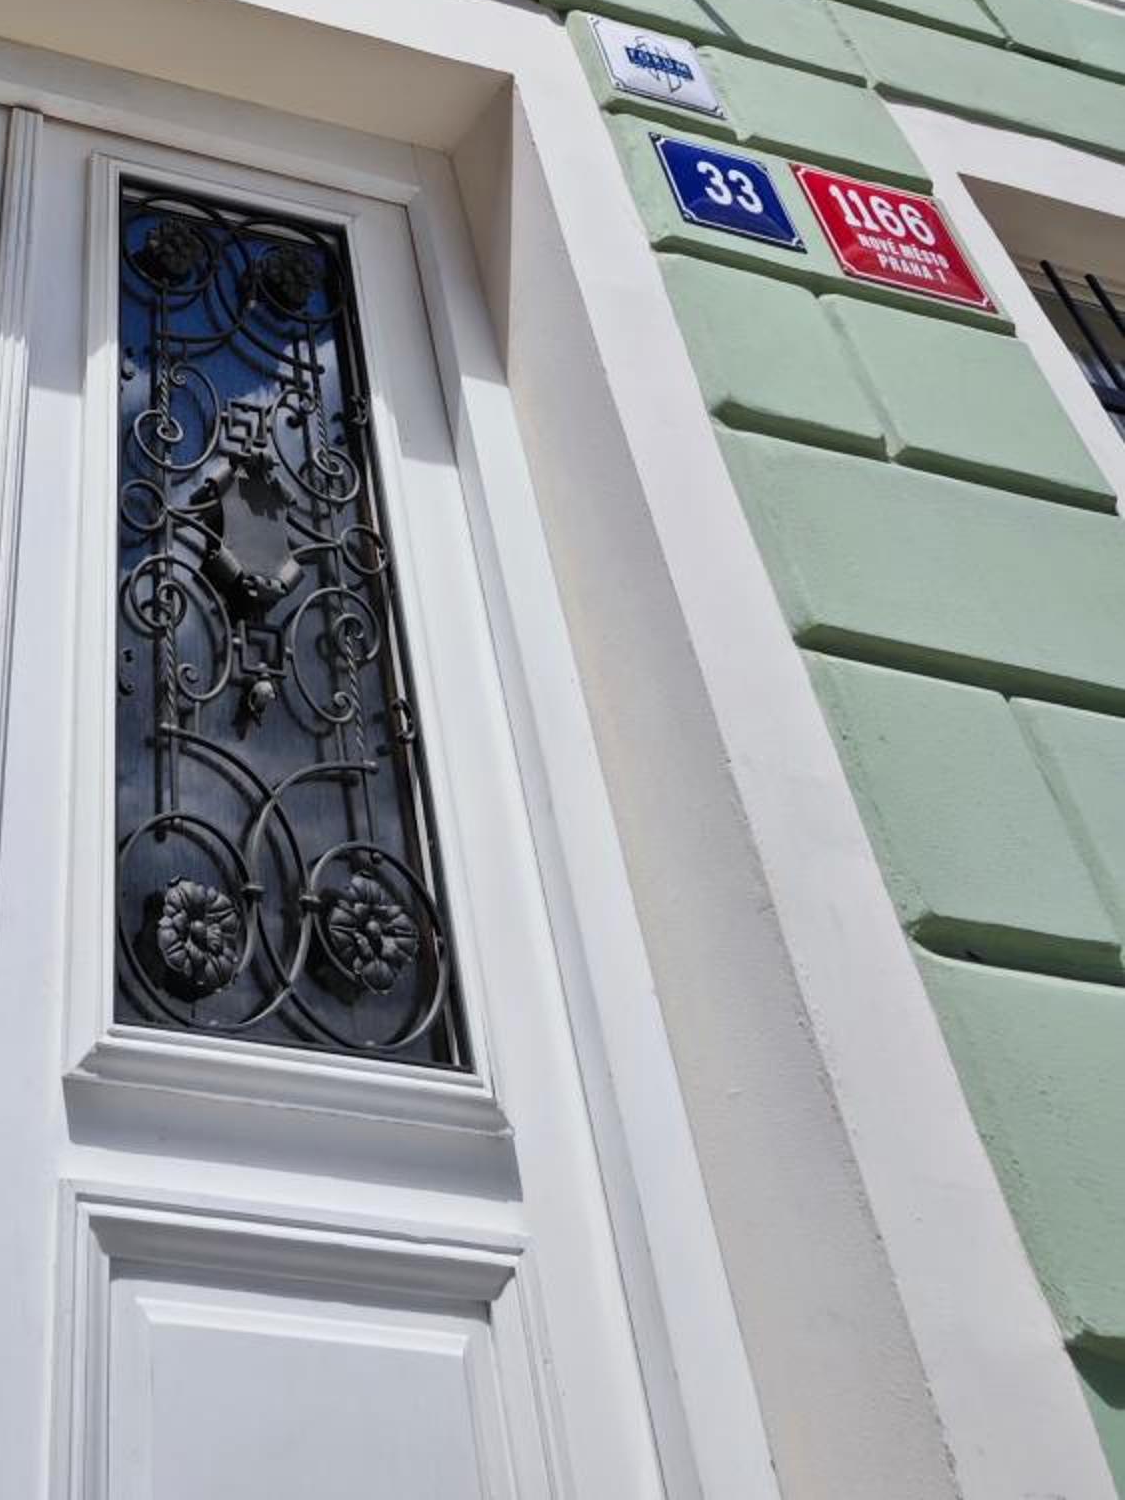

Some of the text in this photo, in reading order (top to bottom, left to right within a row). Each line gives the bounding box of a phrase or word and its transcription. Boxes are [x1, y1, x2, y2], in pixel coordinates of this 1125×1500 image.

[696, 161, 764, 215] 33
[828, 184, 936, 246] 1166
[857, 232, 950, 270] NOVÉ MĚSTO
[876, 252, 948, 285] PRAHA 1
